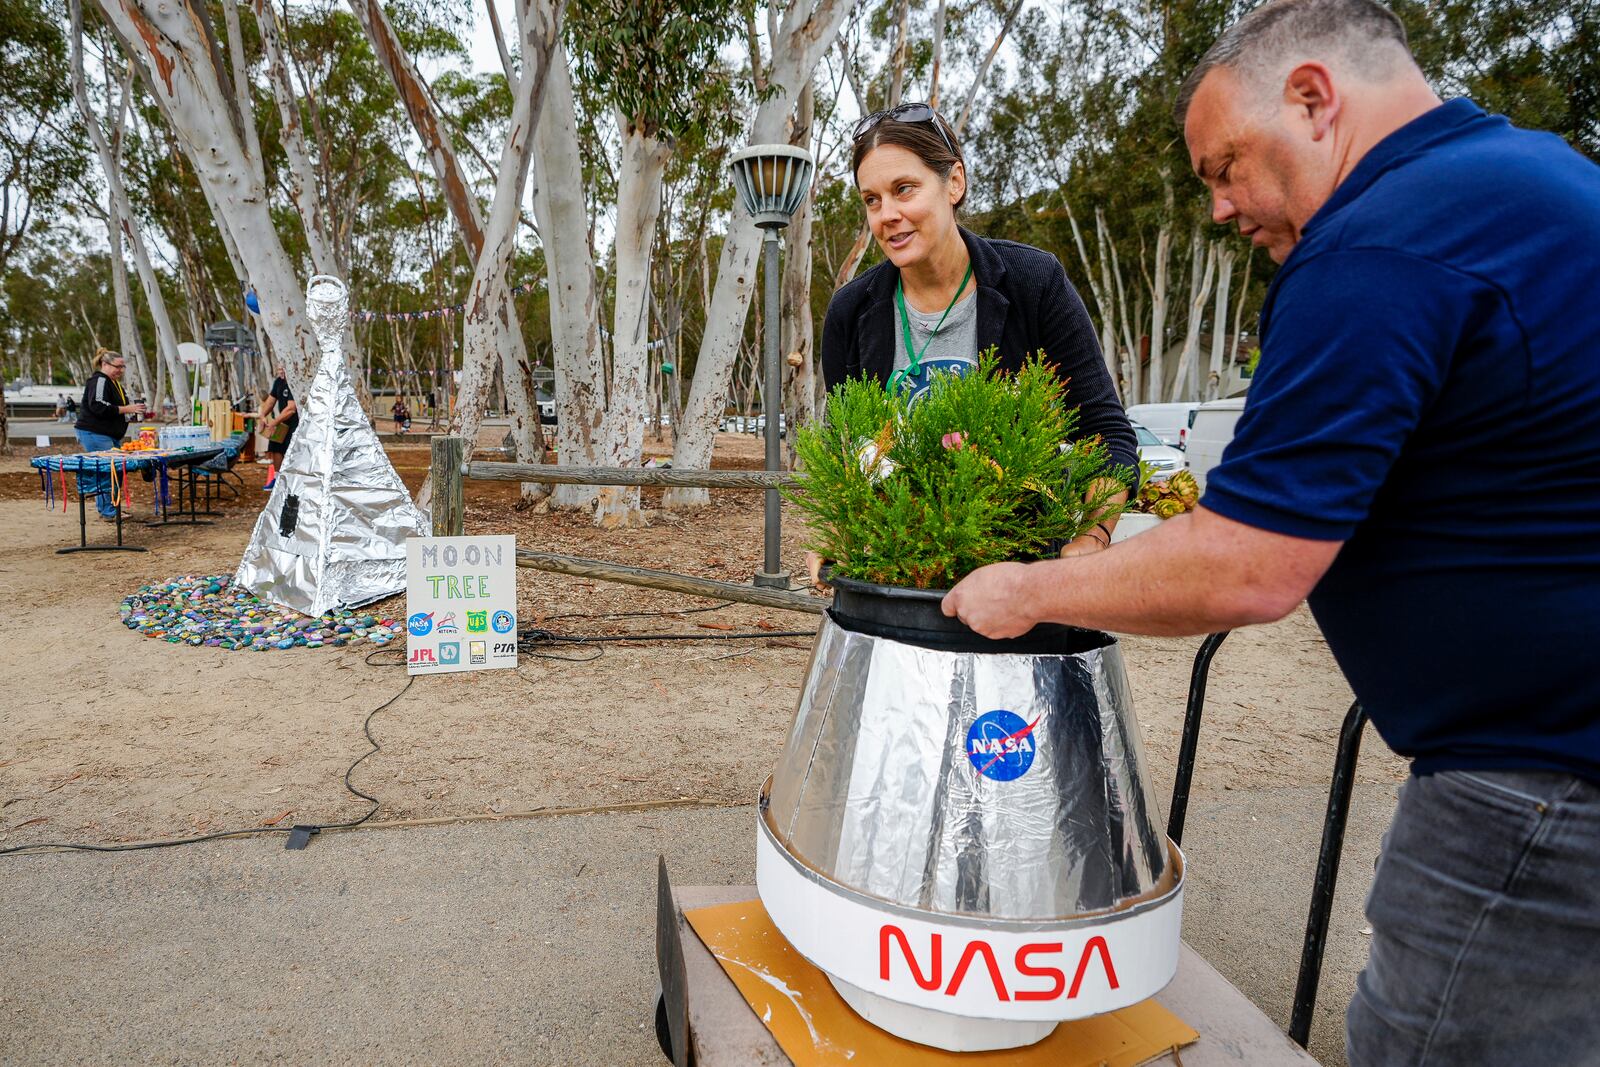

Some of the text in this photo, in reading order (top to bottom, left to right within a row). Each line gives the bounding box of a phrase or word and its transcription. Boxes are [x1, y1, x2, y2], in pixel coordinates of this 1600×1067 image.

[422, 544, 502, 568] MOON
[426, 575, 491, 599] TREE
[409, 649, 436, 662] JPL
[493, 643, 515, 653] PTA
[972, 737, 1033, 753] NASA
[880, 925, 1119, 1002] NASA
